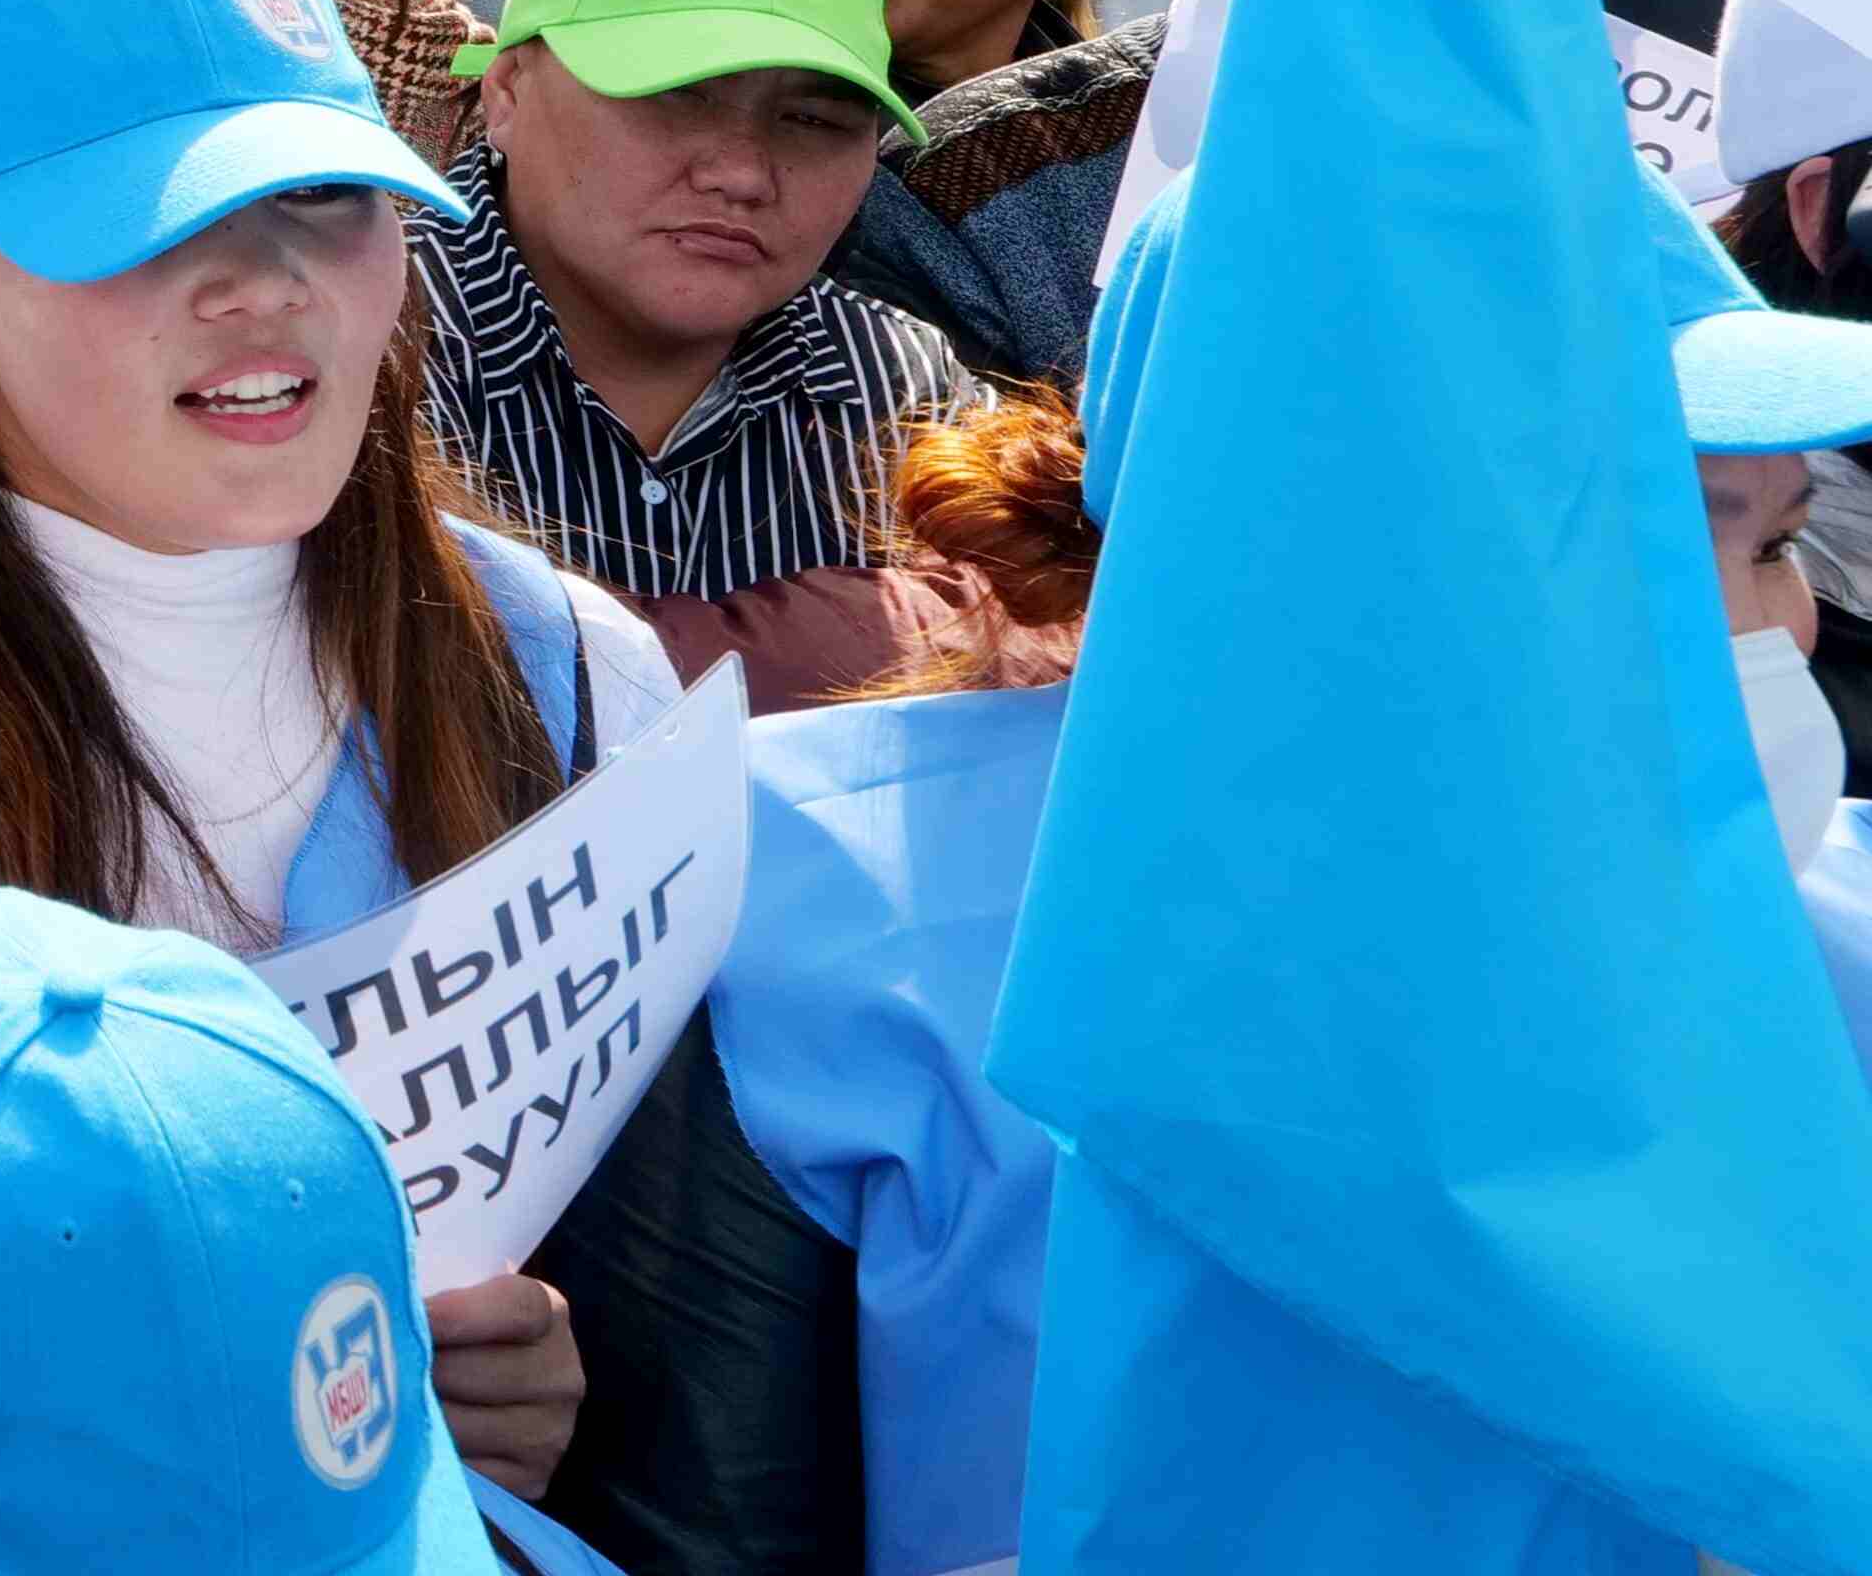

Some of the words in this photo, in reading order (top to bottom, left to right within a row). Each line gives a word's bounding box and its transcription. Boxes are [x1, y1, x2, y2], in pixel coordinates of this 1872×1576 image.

[289, 840, 599, 1058] ЛЫН
[399, 999, 643, 1237] РУУЛ
[325, 1364, 370, 1428] МБШУ
